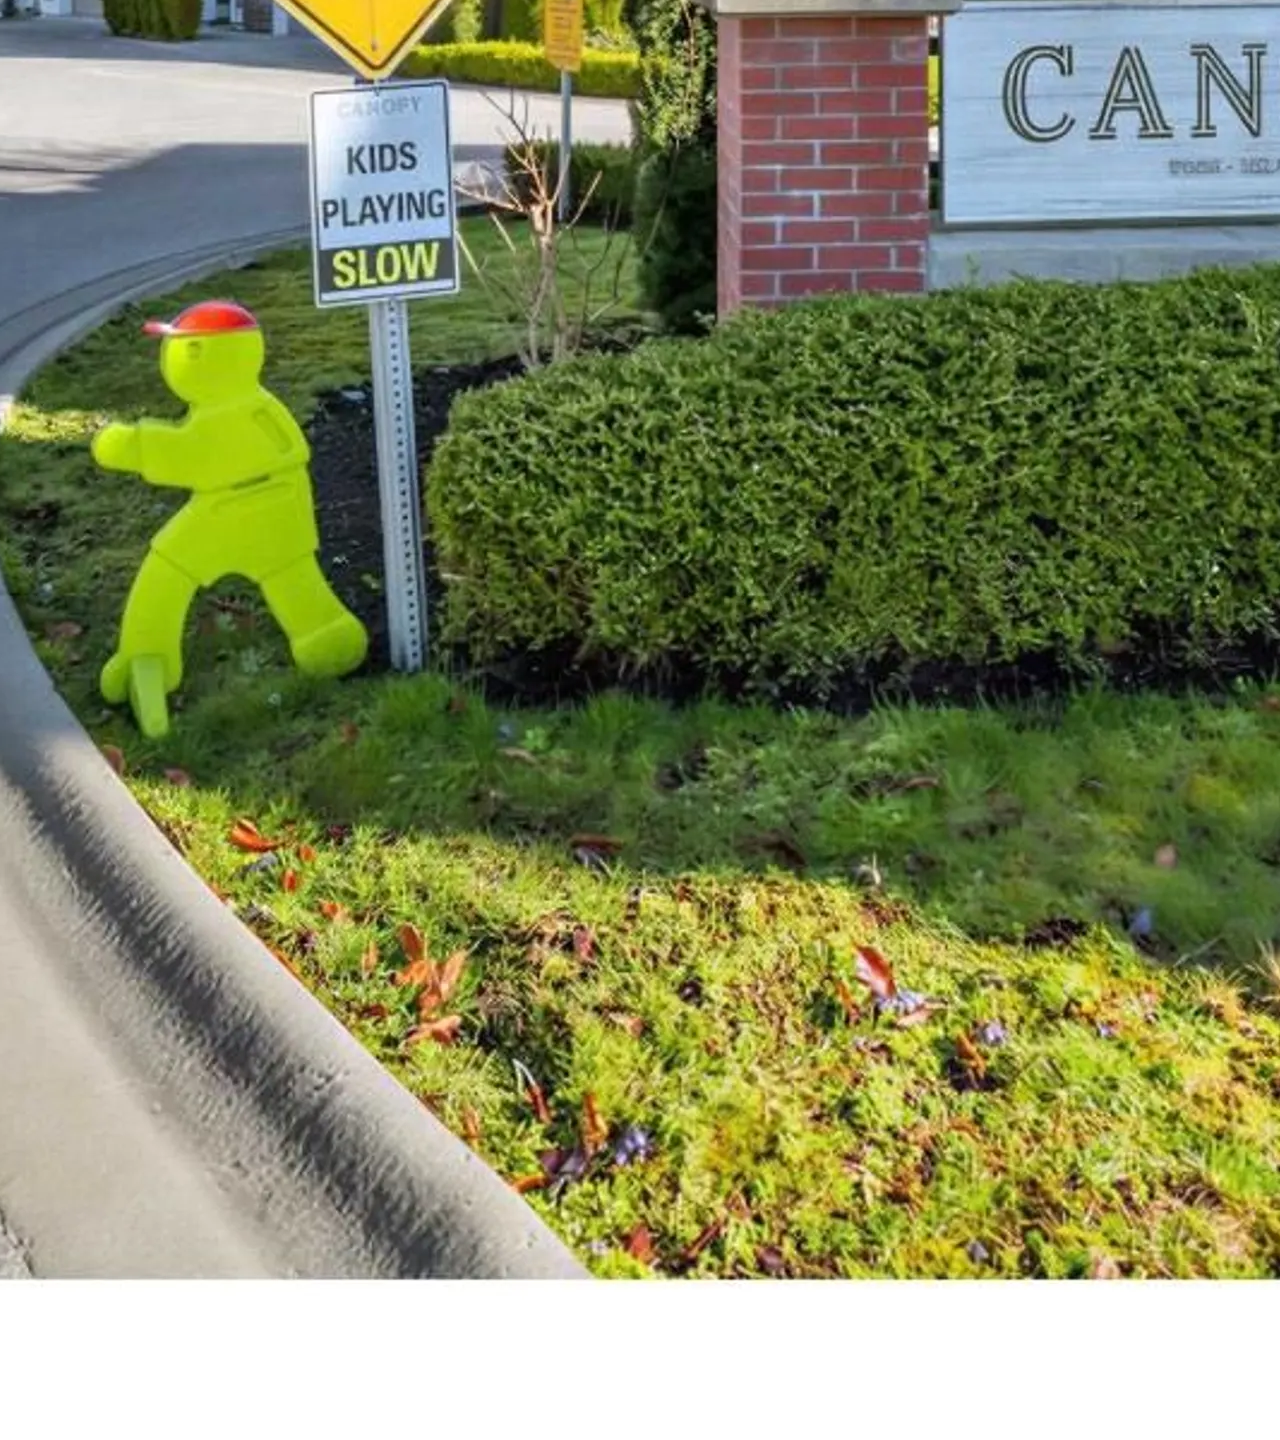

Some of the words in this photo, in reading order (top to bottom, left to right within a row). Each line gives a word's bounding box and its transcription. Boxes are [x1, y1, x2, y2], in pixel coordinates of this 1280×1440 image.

[336, 95, 422, 118] CANOPY
[347, 142, 417, 174] KIDS
[322, 189, 446, 229] PLAYING
[332, 242, 440, 288] SLOW
